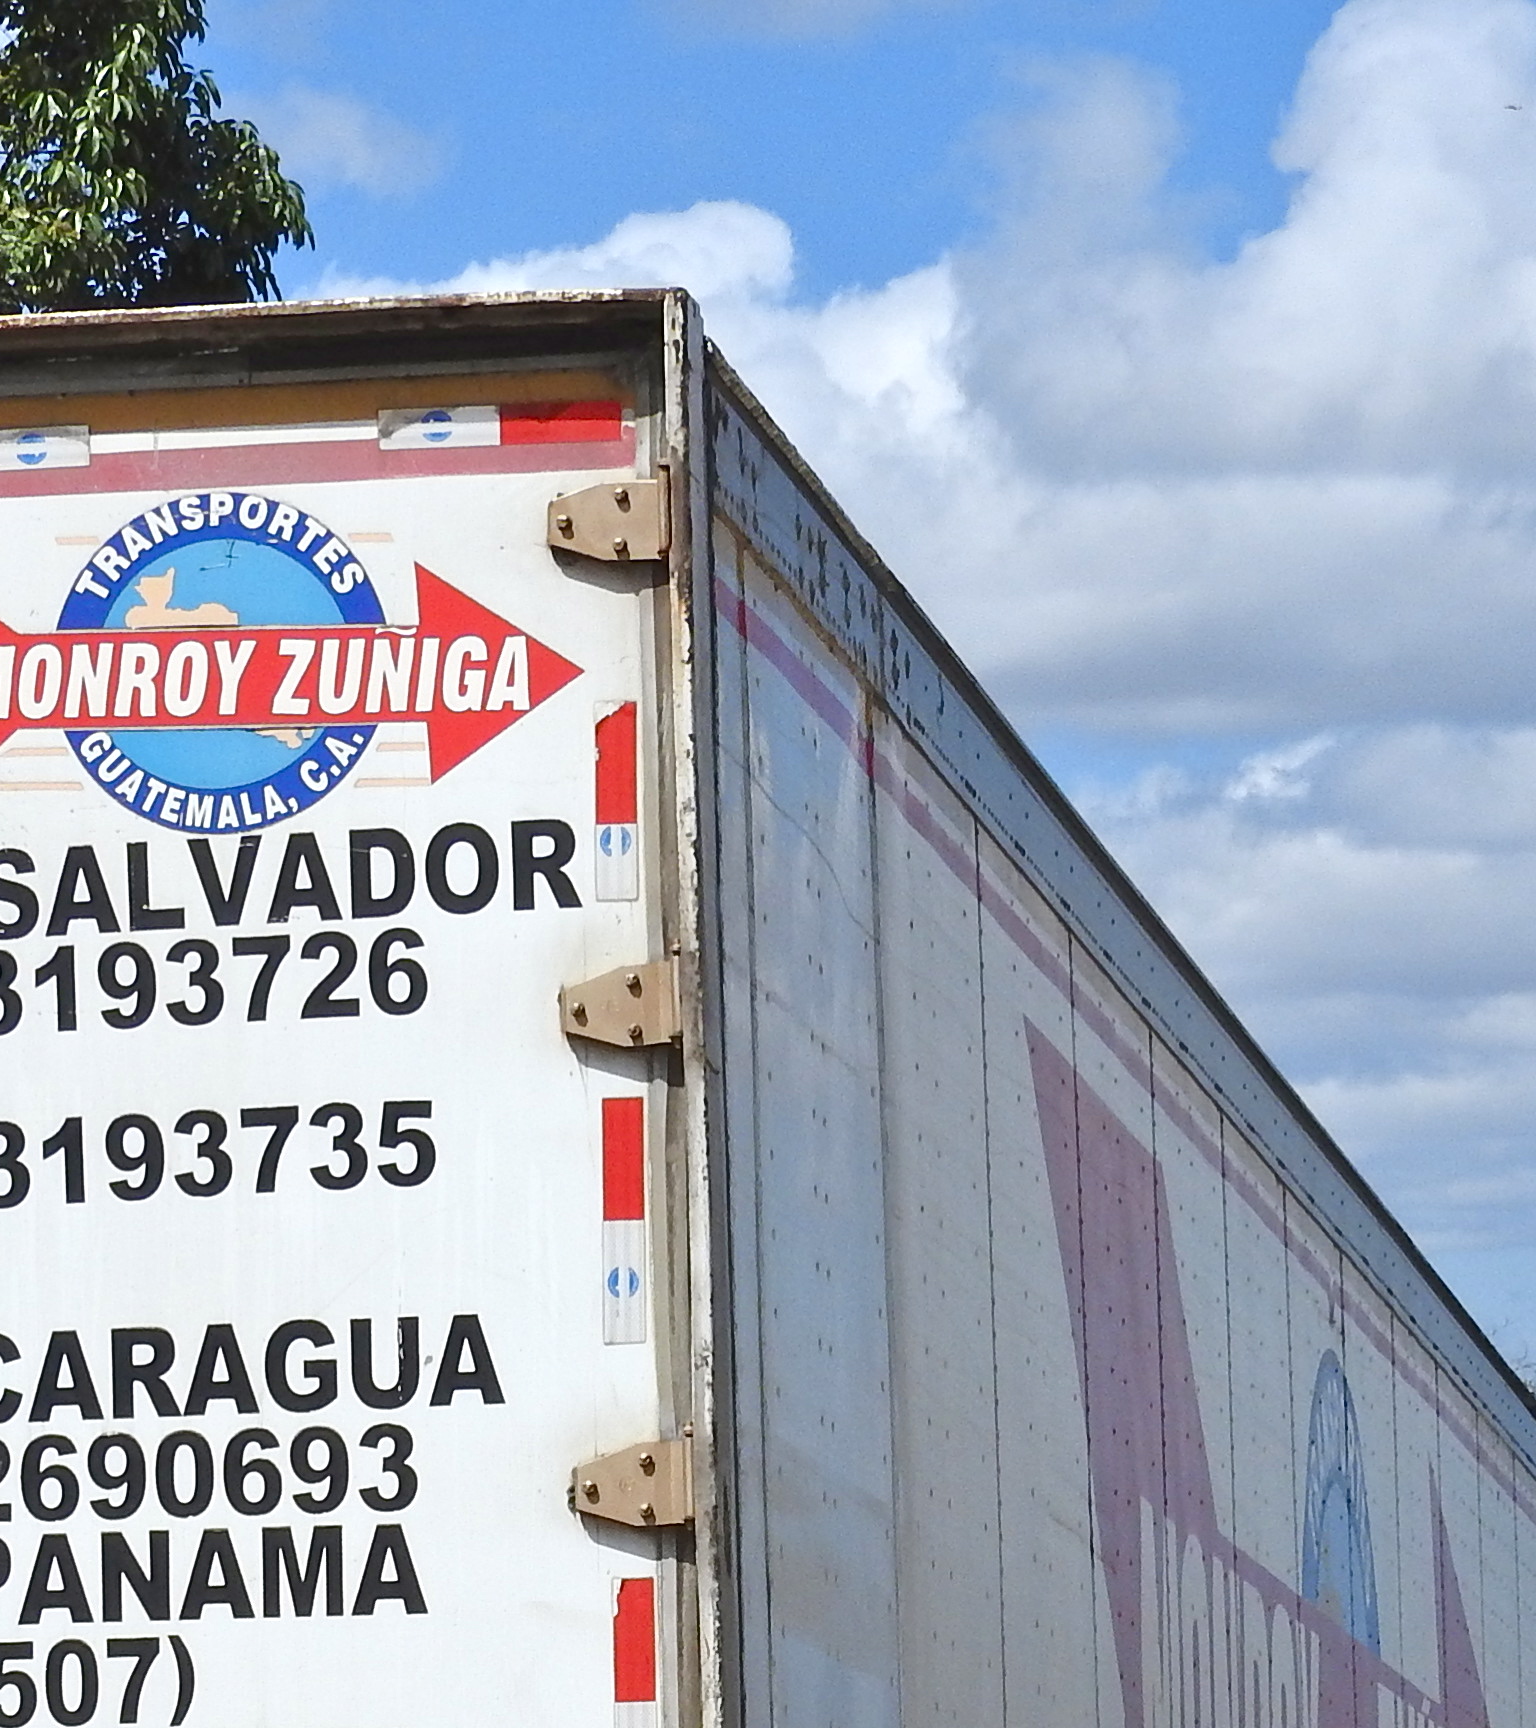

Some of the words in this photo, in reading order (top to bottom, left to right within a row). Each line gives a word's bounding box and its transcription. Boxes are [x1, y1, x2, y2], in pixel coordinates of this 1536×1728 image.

[76, 495, 364, 601] TRANSPORTES
[273, 626, 529, 714] ZUÑIGA
[82, 733, 298, 831] GUATEMALA,
[300, 729, 363, 793] C.A.
